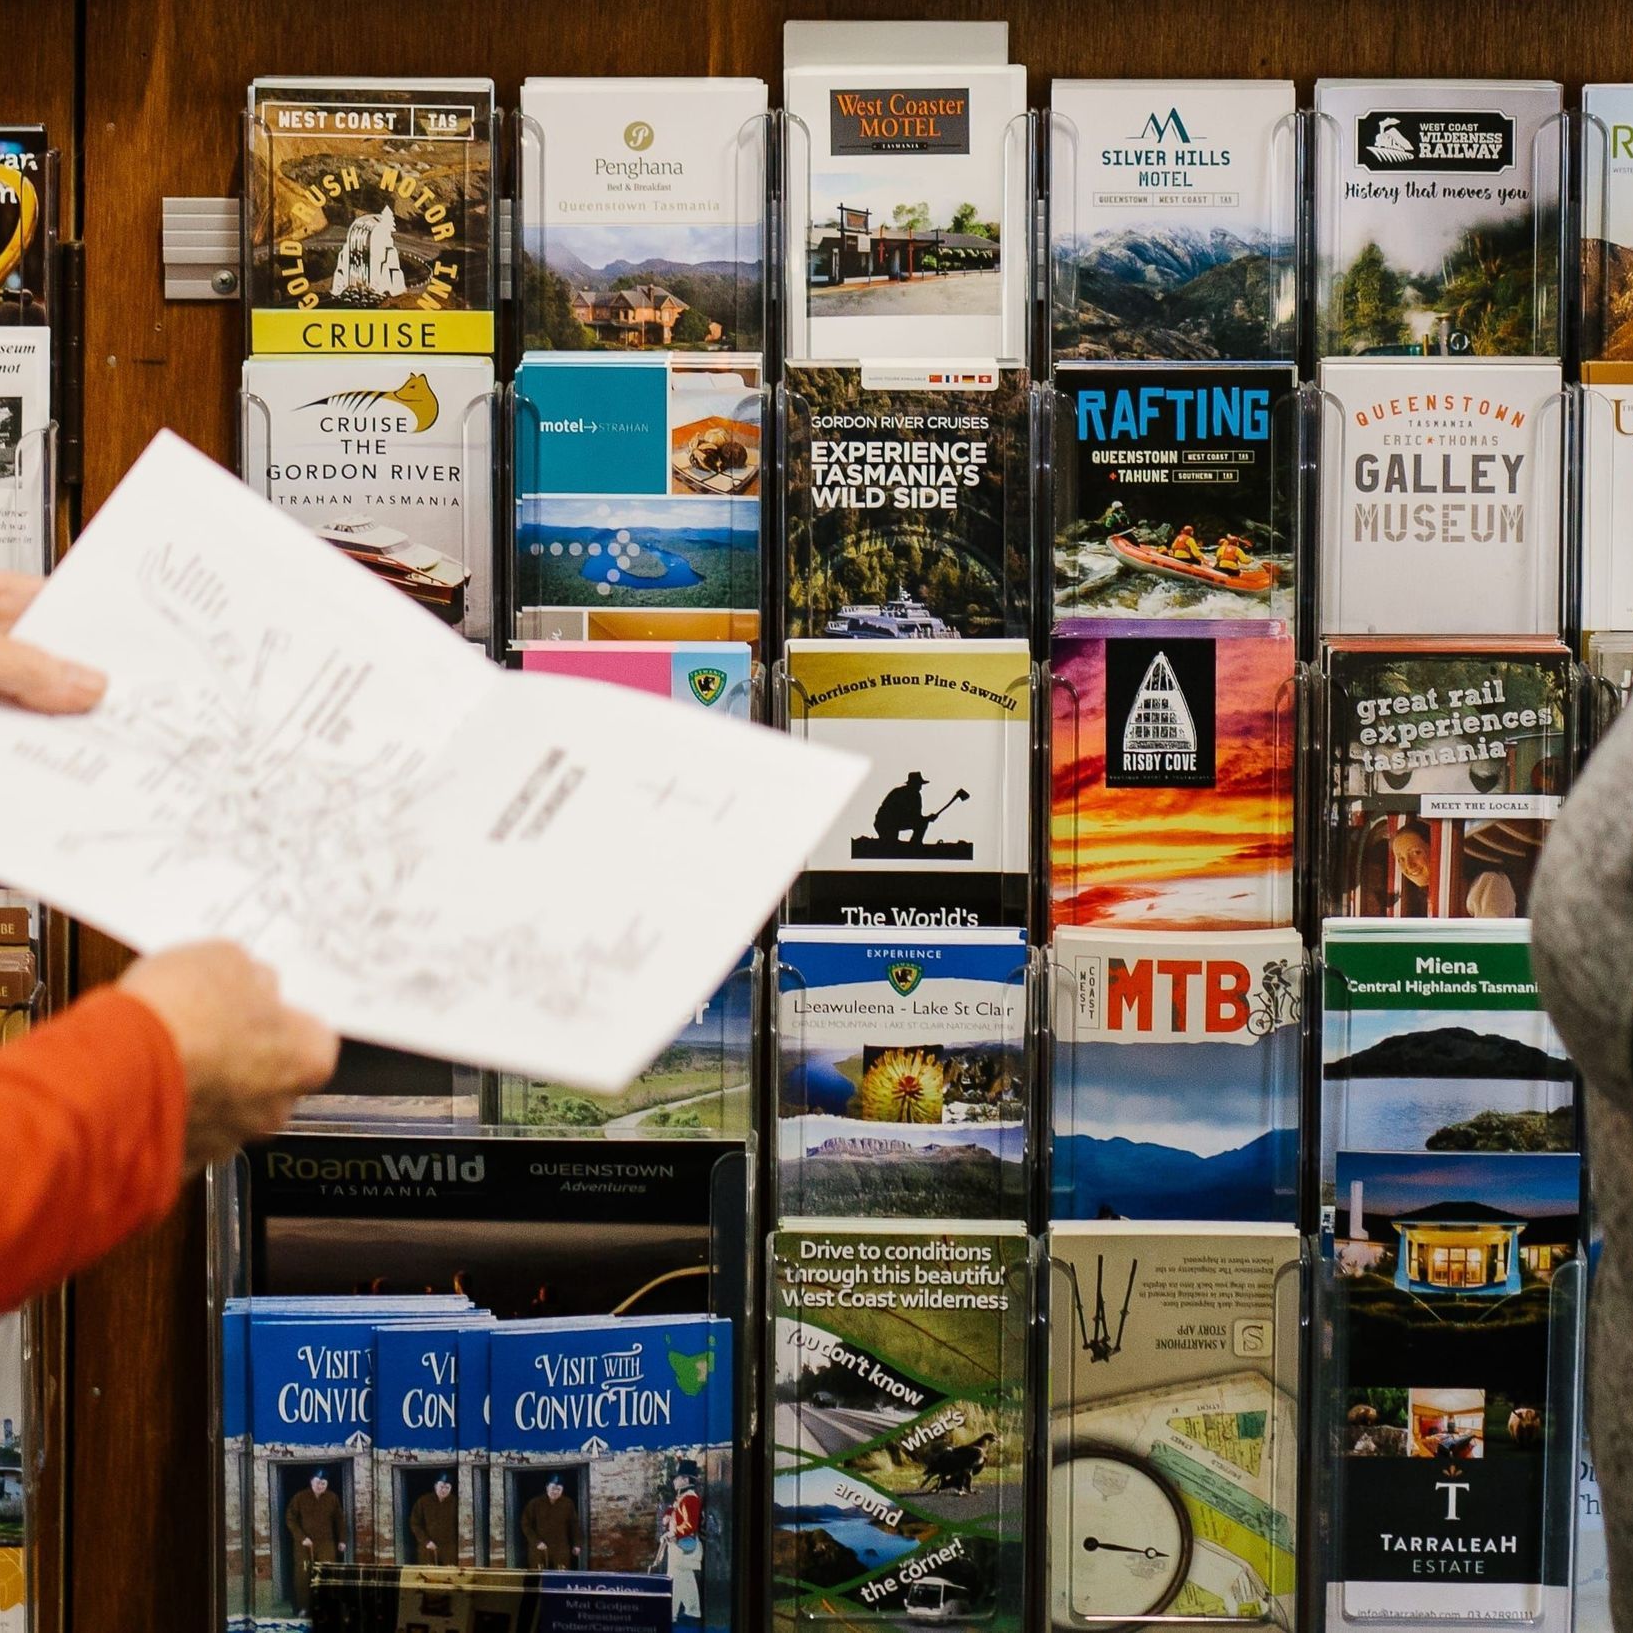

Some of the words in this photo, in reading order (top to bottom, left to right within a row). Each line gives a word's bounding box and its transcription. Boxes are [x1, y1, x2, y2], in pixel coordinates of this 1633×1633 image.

[836, 94, 883, 117] West
[889, 94, 964, 116] Coaster
[859, 118, 941, 138] MOTEL
[1419, 132, 1503, 145] WILDERNESS
[1102, 150, 1168, 166] SILVER
[1175, 151, 1230, 166] HILLS
[1419, 143, 1502, 160] RAILWAY
[594, 158, 683, 178] Penghana
[1138, 171, 1193, 187] MOTEL
[1344, 181, 1401, 202] History
[1405, 182, 1438, 199] that
[1442, 184, 1492, 199] moves
[1497, 187, 1530, 203] you
[302, 323, 437, 348] CRUISE
[1078, 387, 1269, 441] RAFTING
[1355, 394, 1526, 430] QUEENSTOWN
[320, 417, 408, 433] CRUISE
[540, 418, 584, 433] motel
[811, 416, 877, 429] GORDON
[881, 416, 924, 429] RIVER
[927, 416, 989, 430] CRUISES
[341, 438, 387, 455] THE
[811, 442, 987, 463] EXPERIENCE
[1092, 450, 1178, 464] QUEENSTOWN
[811, 465, 980, 486] TASMANIA'S
[1354, 453, 1524, 494] GALLEY
[811, 488, 889, 508] WILD
[893, 488, 957, 509] SIDE
[1354, 503, 1524, 543] MUSEUM
[1357, 688, 1438, 724] great
[1448, 680, 1505, 709] rail
[1359, 708, 1553, 748] experiences
[1123, 753, 1161, 772] RISBY
[1165, 754, 1197, 771] COVE
[1362, 737, 1507, 772] tasmania
[866, 949, 942, 959] EXPERIENCE
[1107, 957, 1251, 1033] MTB
[800, 1242, 854, 1262] Drive
[858, 1243, 881, 1261] to
[885, 1242, 991, 1262] conditions
